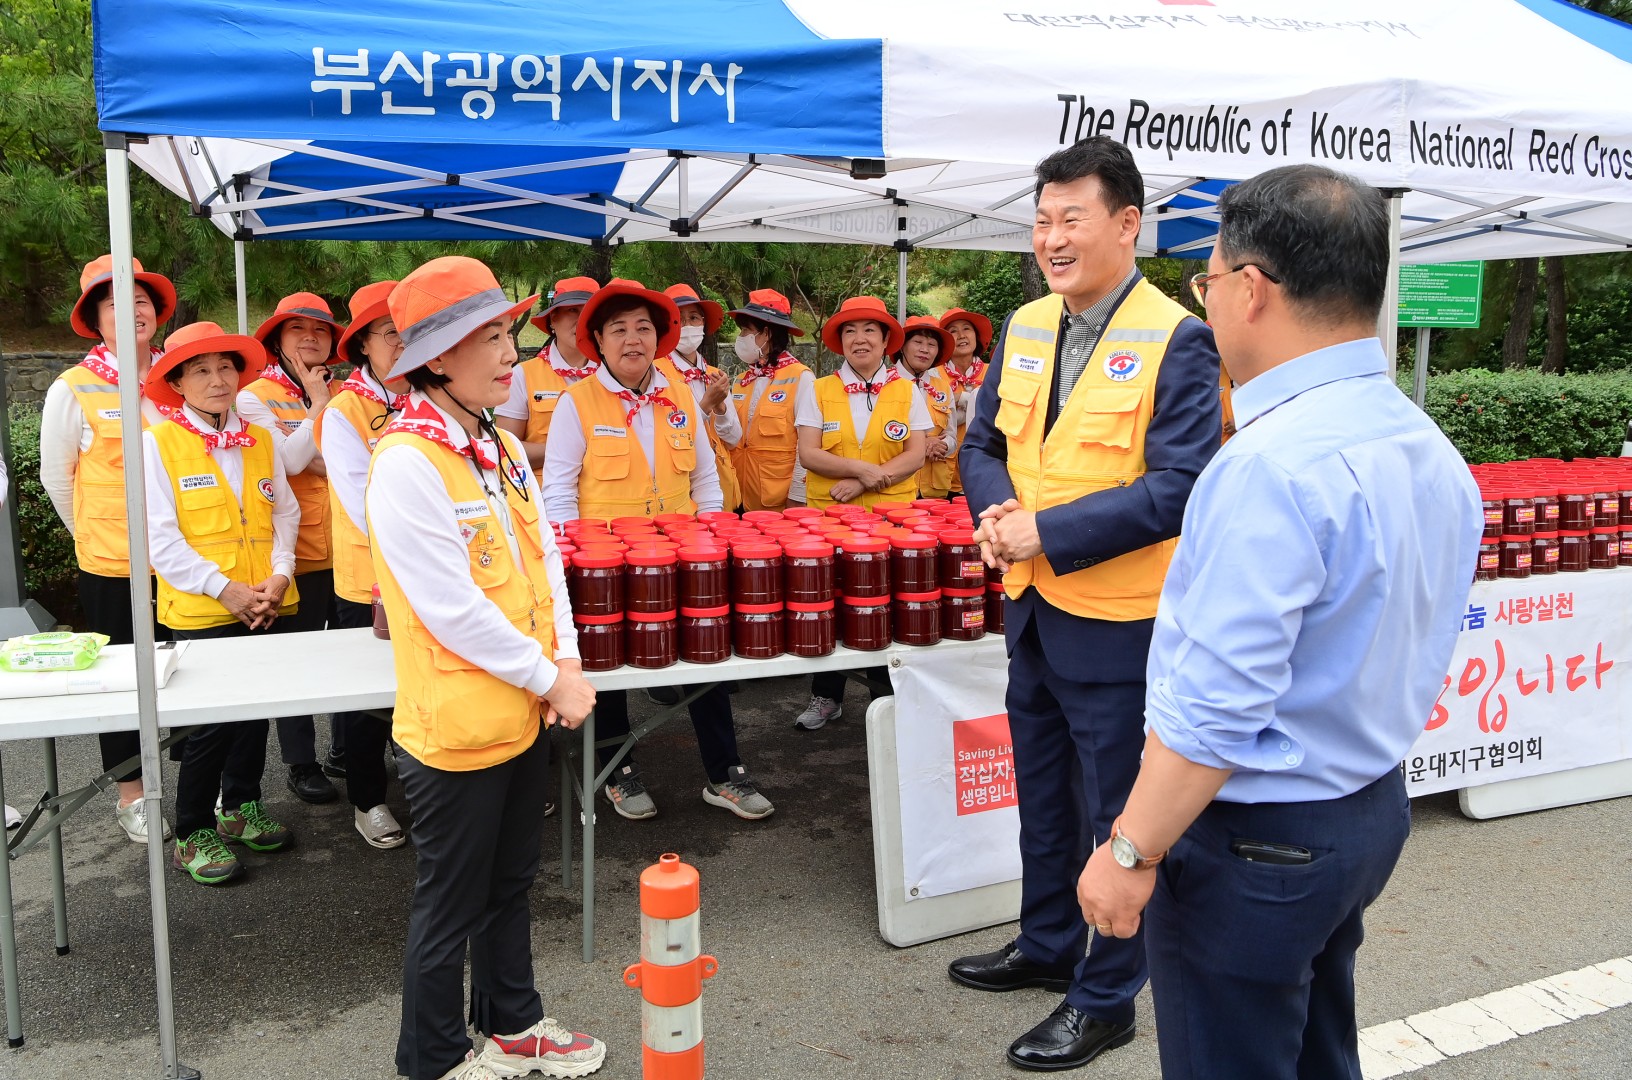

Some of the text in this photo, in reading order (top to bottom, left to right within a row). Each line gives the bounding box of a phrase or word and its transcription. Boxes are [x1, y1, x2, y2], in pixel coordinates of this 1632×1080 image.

[310, 46, 743, 124] 부산광역시지사
[1057, 93, 1116, 145] The
[1123, 98, 1251, 161] Republic
[1261, 108, 1293, 156] of
[1310, 111, 1392, 162] Korea
[1409, 119, 1515, 171] National
[1528, 128, 1579, 175] Red
[1494, 592, 1574, 625] 사랑실천
[958, 744, 1013, 761] Saving Liv
[960, 759, 1015, 785] 적십자
[961, 782, 1015, 807] 생명입니
